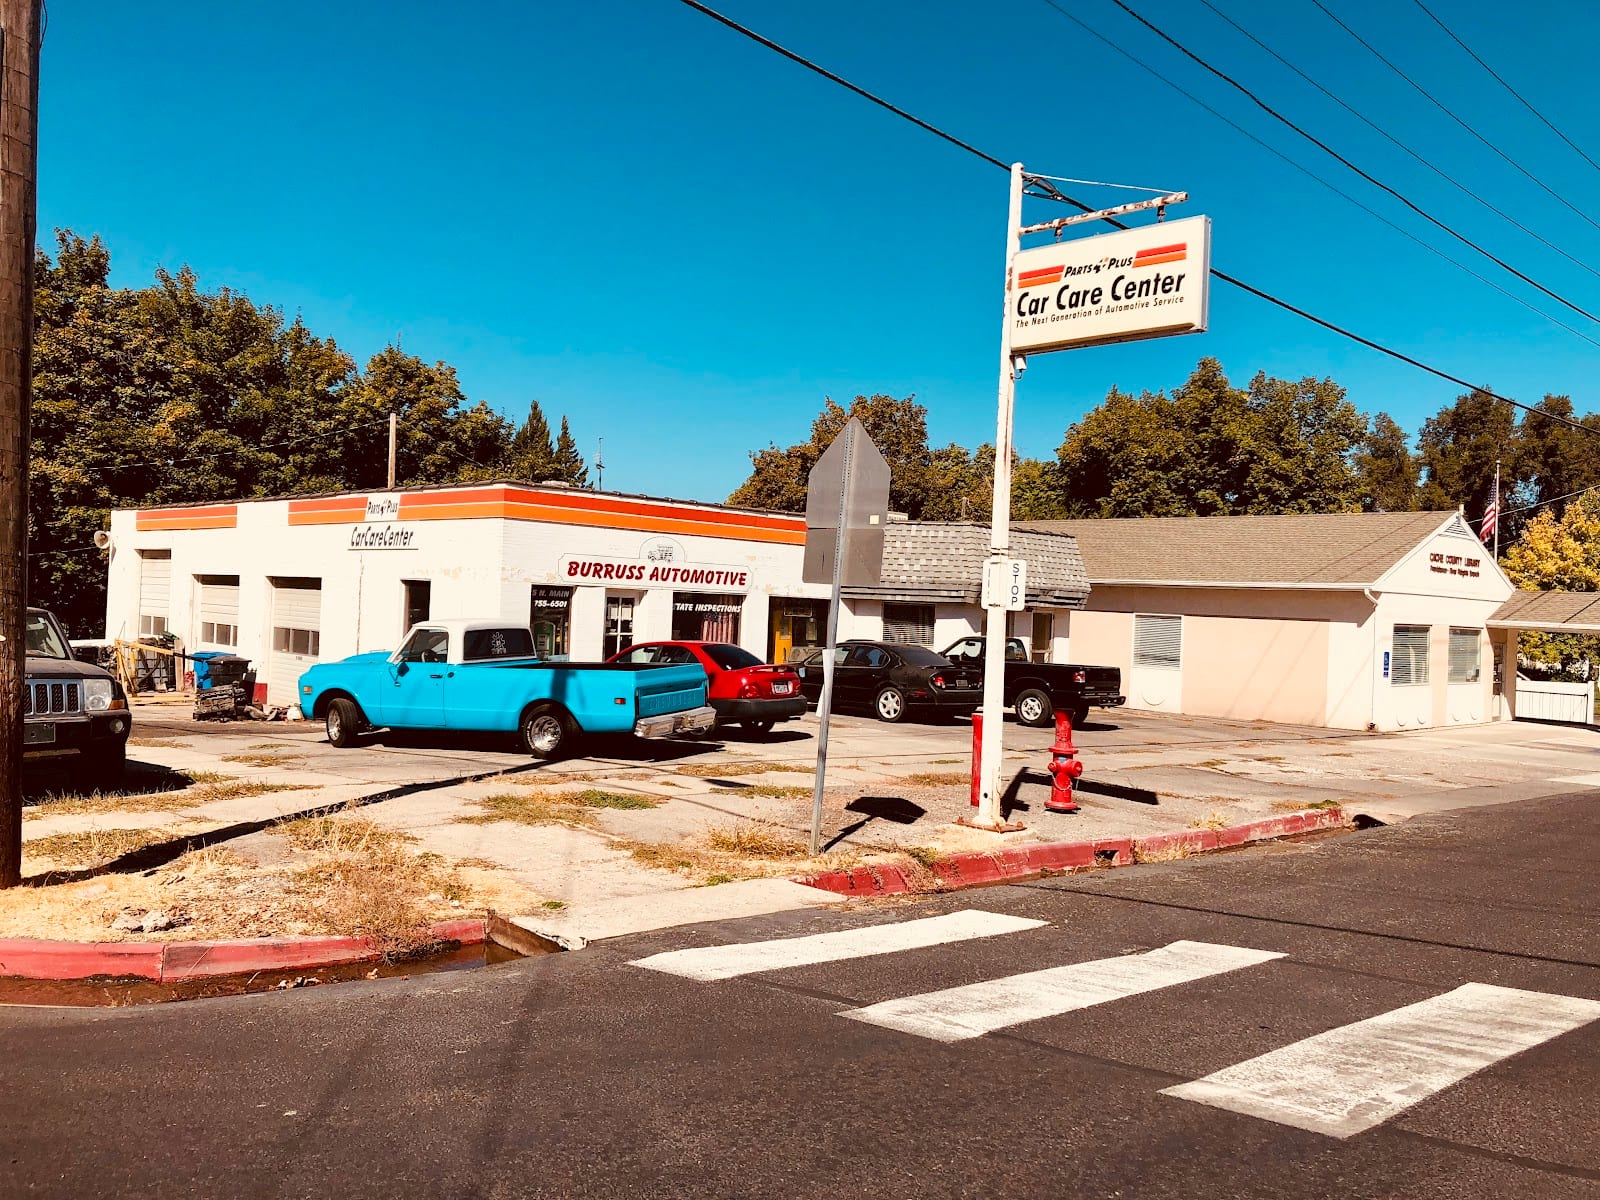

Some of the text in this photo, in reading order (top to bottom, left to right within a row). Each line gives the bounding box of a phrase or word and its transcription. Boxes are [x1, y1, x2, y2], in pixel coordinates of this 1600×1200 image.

[1064, 256, 1133, 278] PARTS PLUS
[1016, 272, 1186, 317] Car Care Center
[1016, 295, 1184, 328] The Next Generation of Automotive Service
[567, 560, 748, 587] BURRUSS AUTOMOTIVE
[1011, 563, 1020, 606] STOP
[534, 599, 568, 608] 755-6501
[549, 590, 570, 598] MAIN
[695, 603, 742, 613] INSPECTIONS
